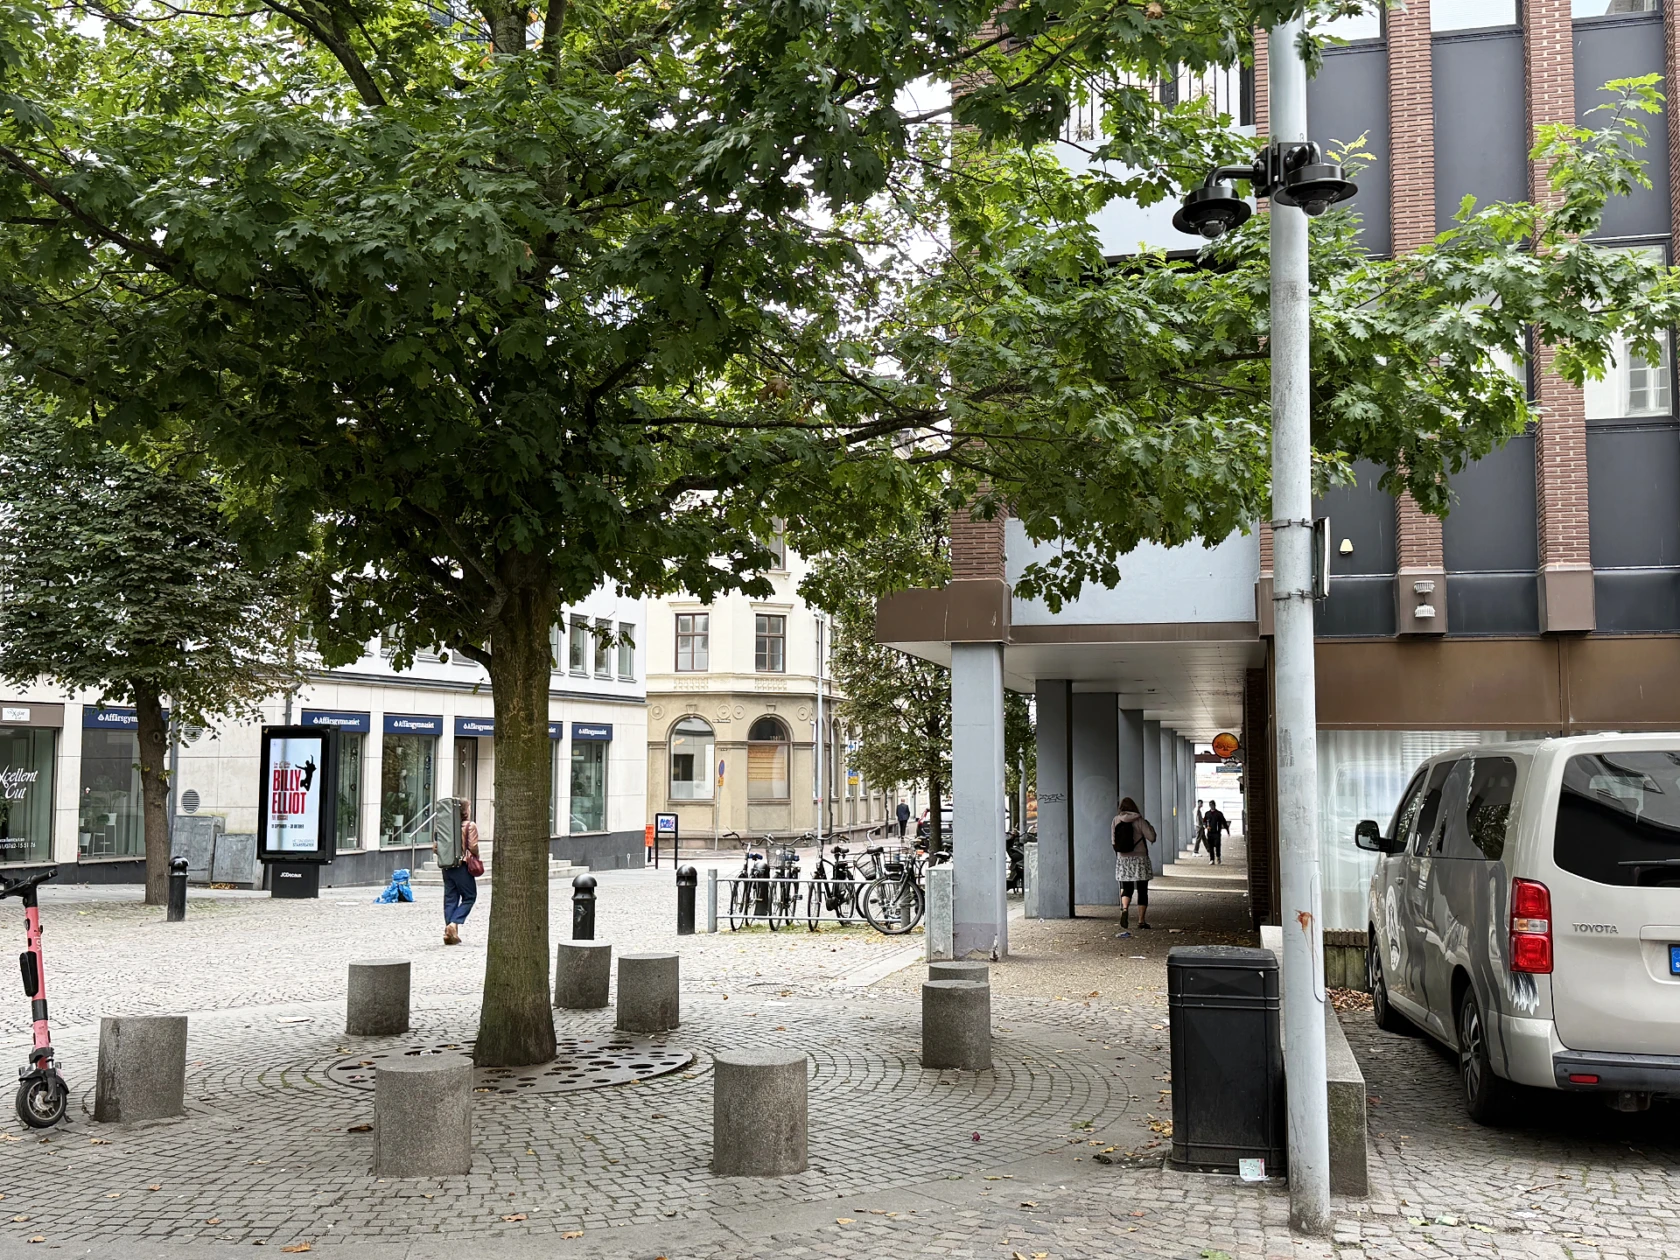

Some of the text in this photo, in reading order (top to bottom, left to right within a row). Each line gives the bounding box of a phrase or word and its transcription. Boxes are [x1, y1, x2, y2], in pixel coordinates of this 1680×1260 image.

[104, 713, 139, 724] Affärsgym
[272, 769, 302, 792] BILLY
[5, 782, 27, 799] Cut
[271, 791, 306, 815] ELLIOT
[1572, 923, 1619, 934] TOYOTA
